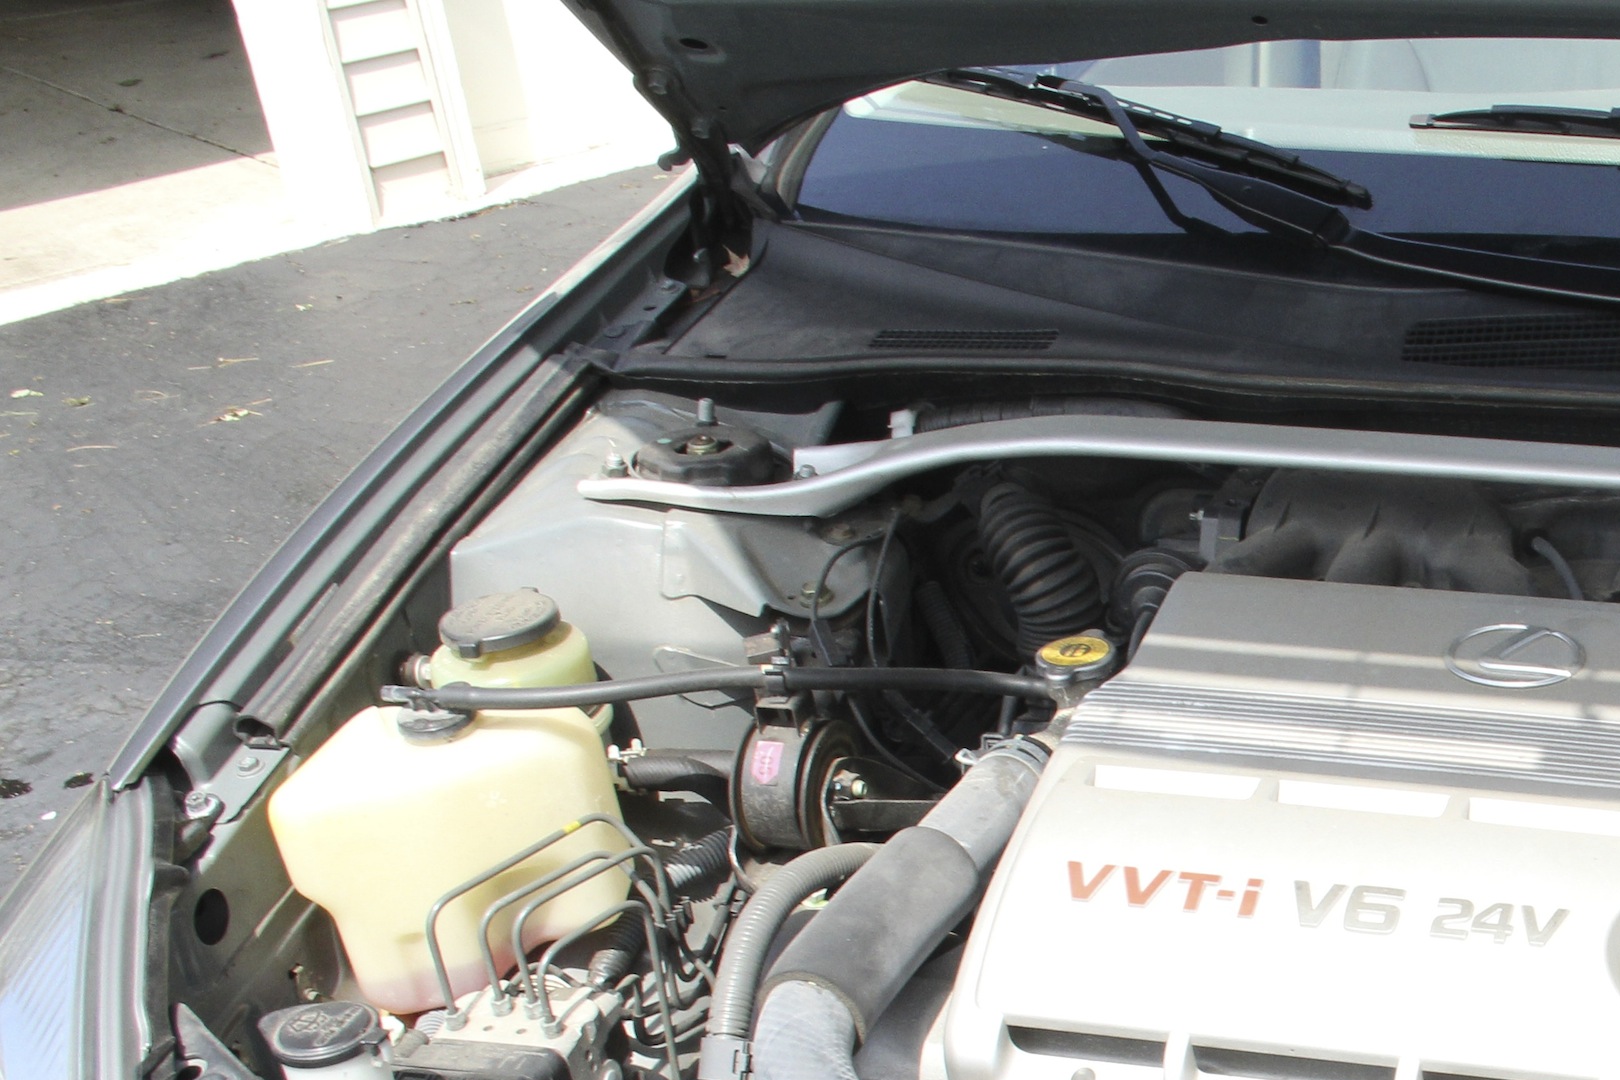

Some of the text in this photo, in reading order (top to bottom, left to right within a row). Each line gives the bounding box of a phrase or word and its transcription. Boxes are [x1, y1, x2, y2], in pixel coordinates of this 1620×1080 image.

[1067, 861, 1570, 948] VVT-i V6 24V
